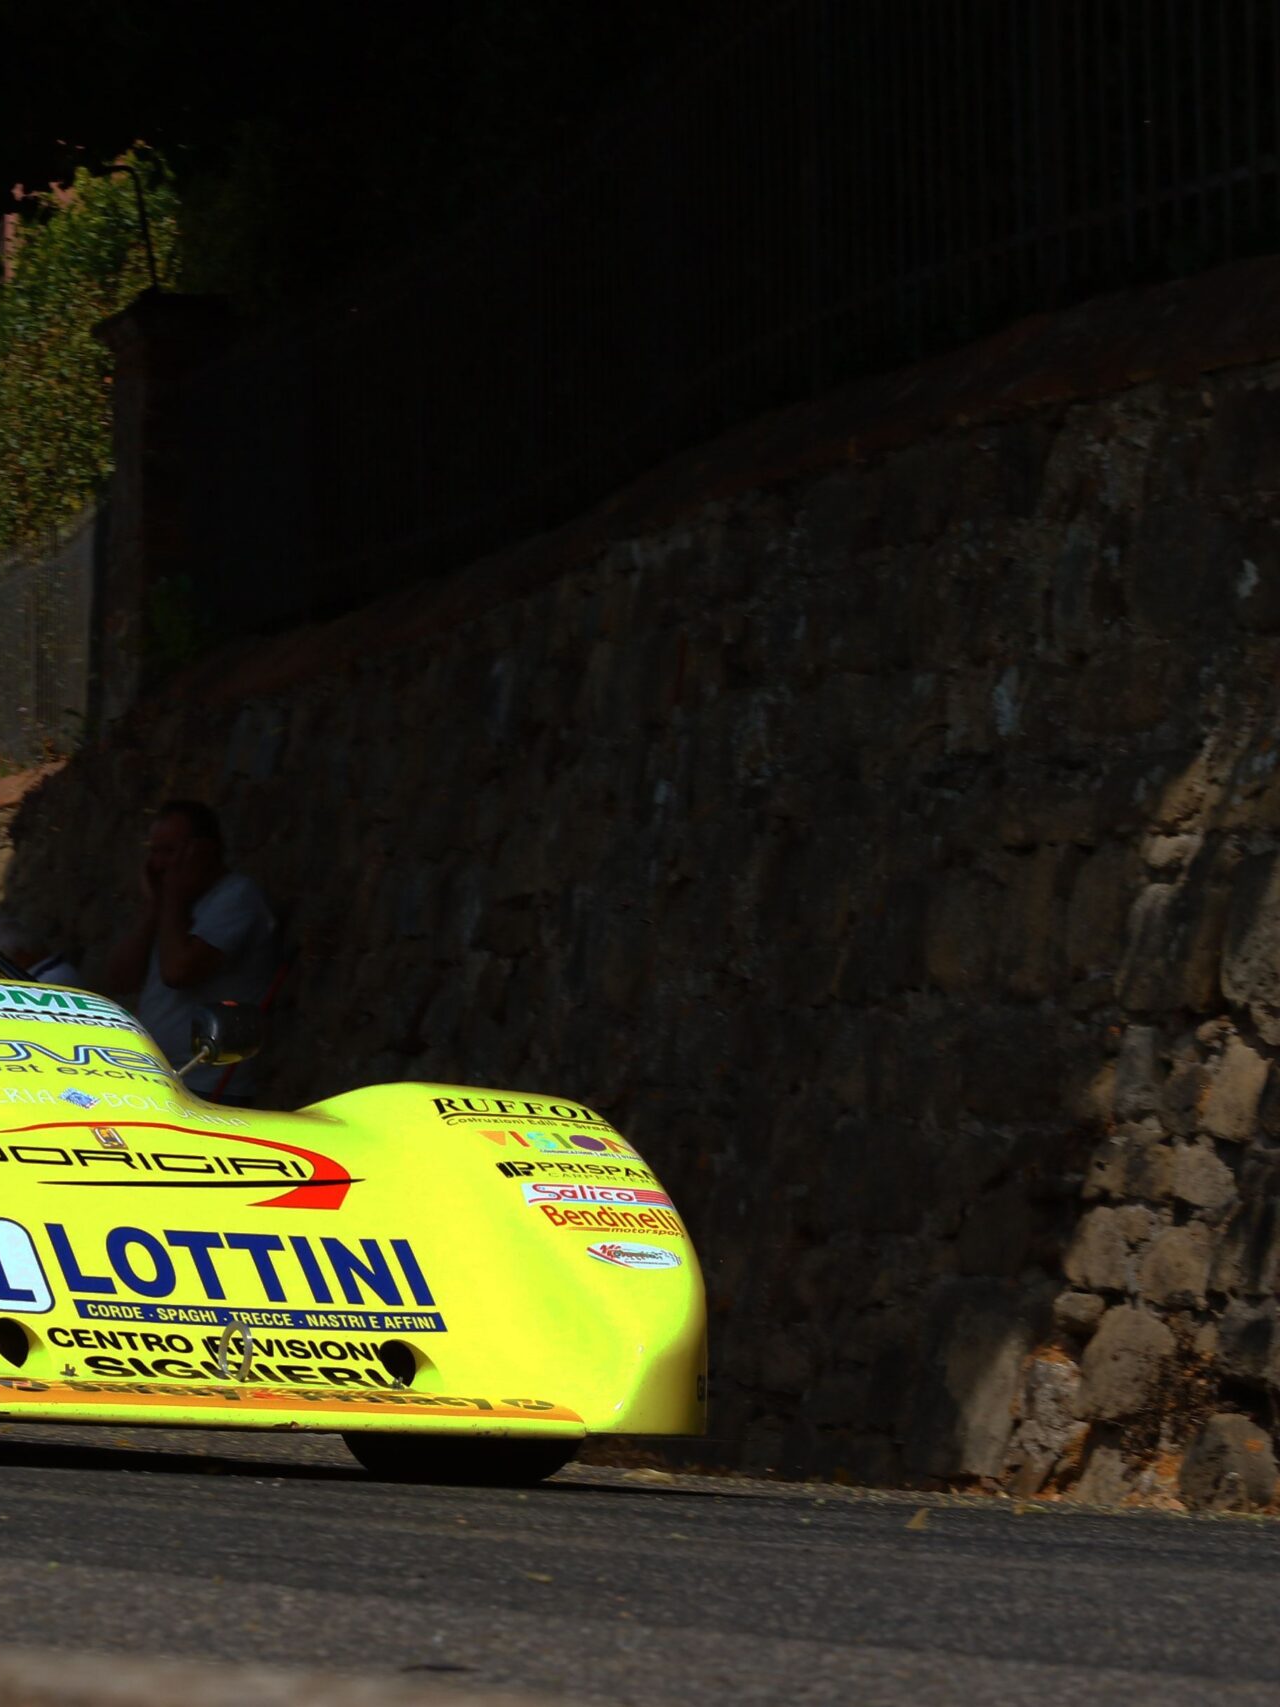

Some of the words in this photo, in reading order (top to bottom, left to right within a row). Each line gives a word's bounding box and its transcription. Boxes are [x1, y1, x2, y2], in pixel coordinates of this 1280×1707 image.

[446, 1116, 525, 1127] Costruzioni
[539, 1204, 685, 1233] Bendinelli
[44, 1223, 436, 1308] LOTTINI
[87, 1303, 145, 1320] CORDE
[158, 1307, 218, 1324] SPAGHI
[229, 1311, 295, 1328] TRECCE
[307, 1314, 367, 1329] NASTRI
[370, 1315, 381, 1329] E
[384, 1316, 437, 1330] AFFINI
[46, 1326, 195, 1354] CENTRO
[203, 1335, 382, 1363] REVISIONI
